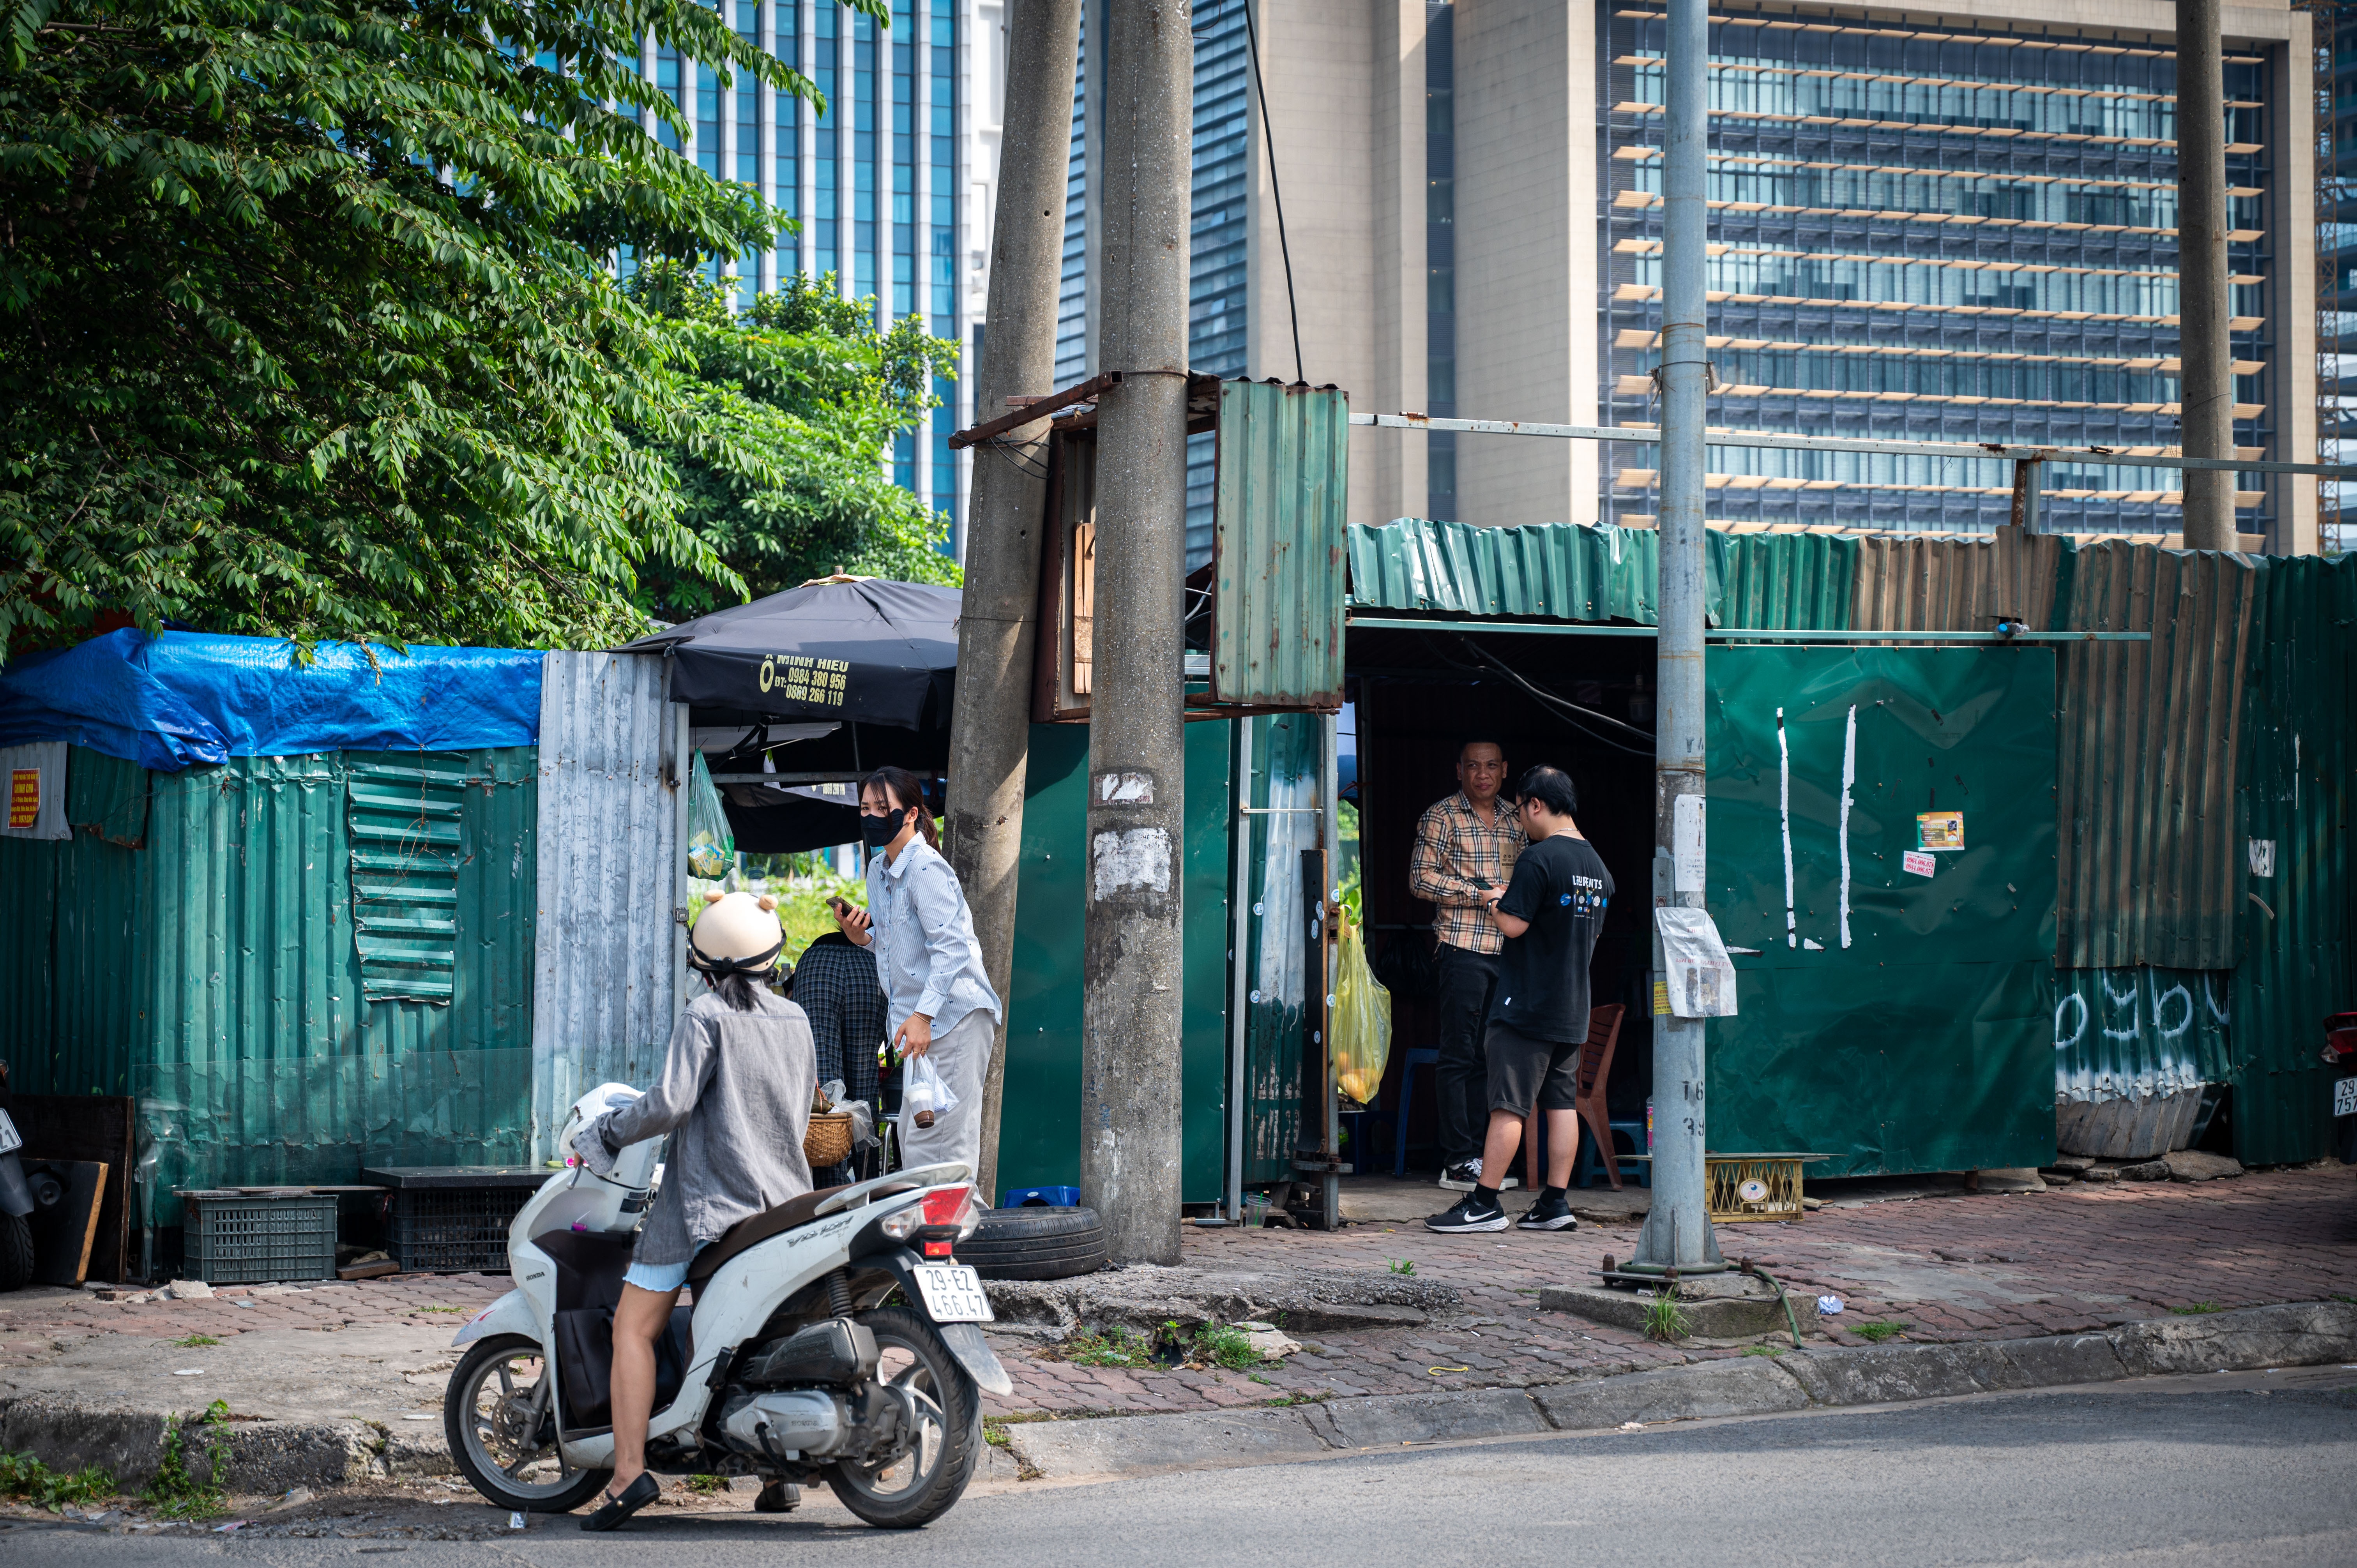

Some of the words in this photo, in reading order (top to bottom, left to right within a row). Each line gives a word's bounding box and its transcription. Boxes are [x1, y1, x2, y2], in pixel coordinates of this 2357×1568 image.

[777, 655, 814, 667] MINH
[788, 667, 809, 685] 0984
[811, 670, 828, 687] 380
[829, 673, 846, 690] 956
[786, 684, 808, 701] 0869
[808, 687, 825, 703] 266
[827, 690, 844, 706] 119
[787, 1215, 854, 1248] VISION
[526, 1271, 545, 1281] HONDA
[926, 1270, 974, 1291] 29-E2
[932, 1295, 984, 1316] 466.47
